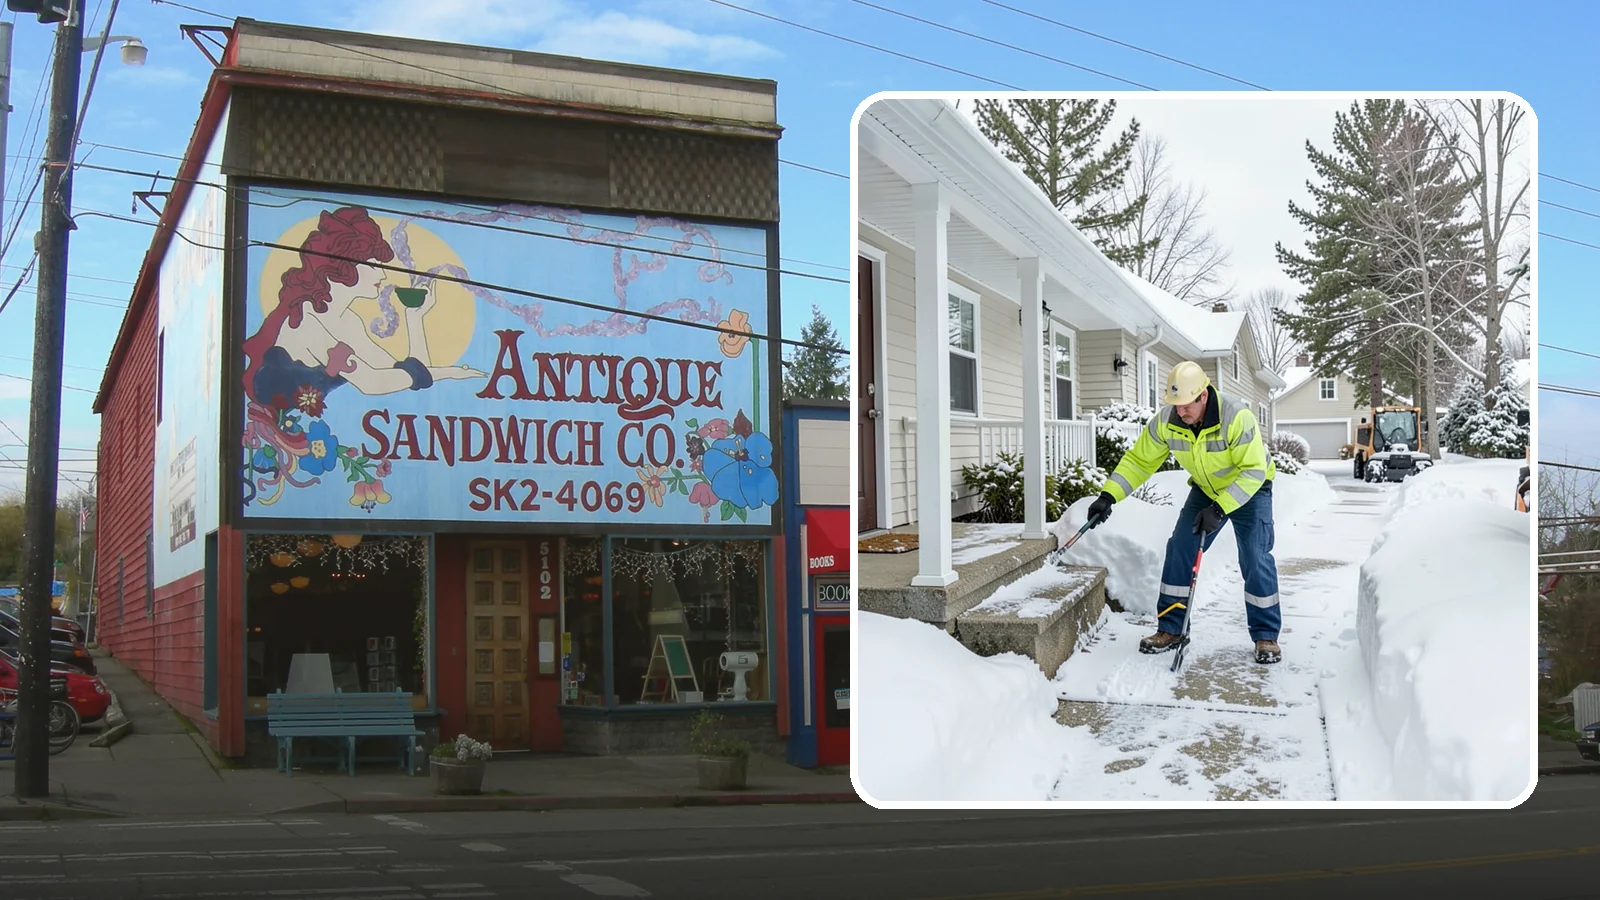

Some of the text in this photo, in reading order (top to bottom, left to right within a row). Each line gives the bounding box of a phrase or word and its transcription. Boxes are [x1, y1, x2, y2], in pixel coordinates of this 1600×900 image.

[476, 329, 724, 421] ANTIQUE
[361, 408, 686, 470] SANDWICH CO.
[468, 477, 646, 514] SK2-4069
[539, 541, 552, 601] 5102
[809, 555, 835, 569] BOOKS
